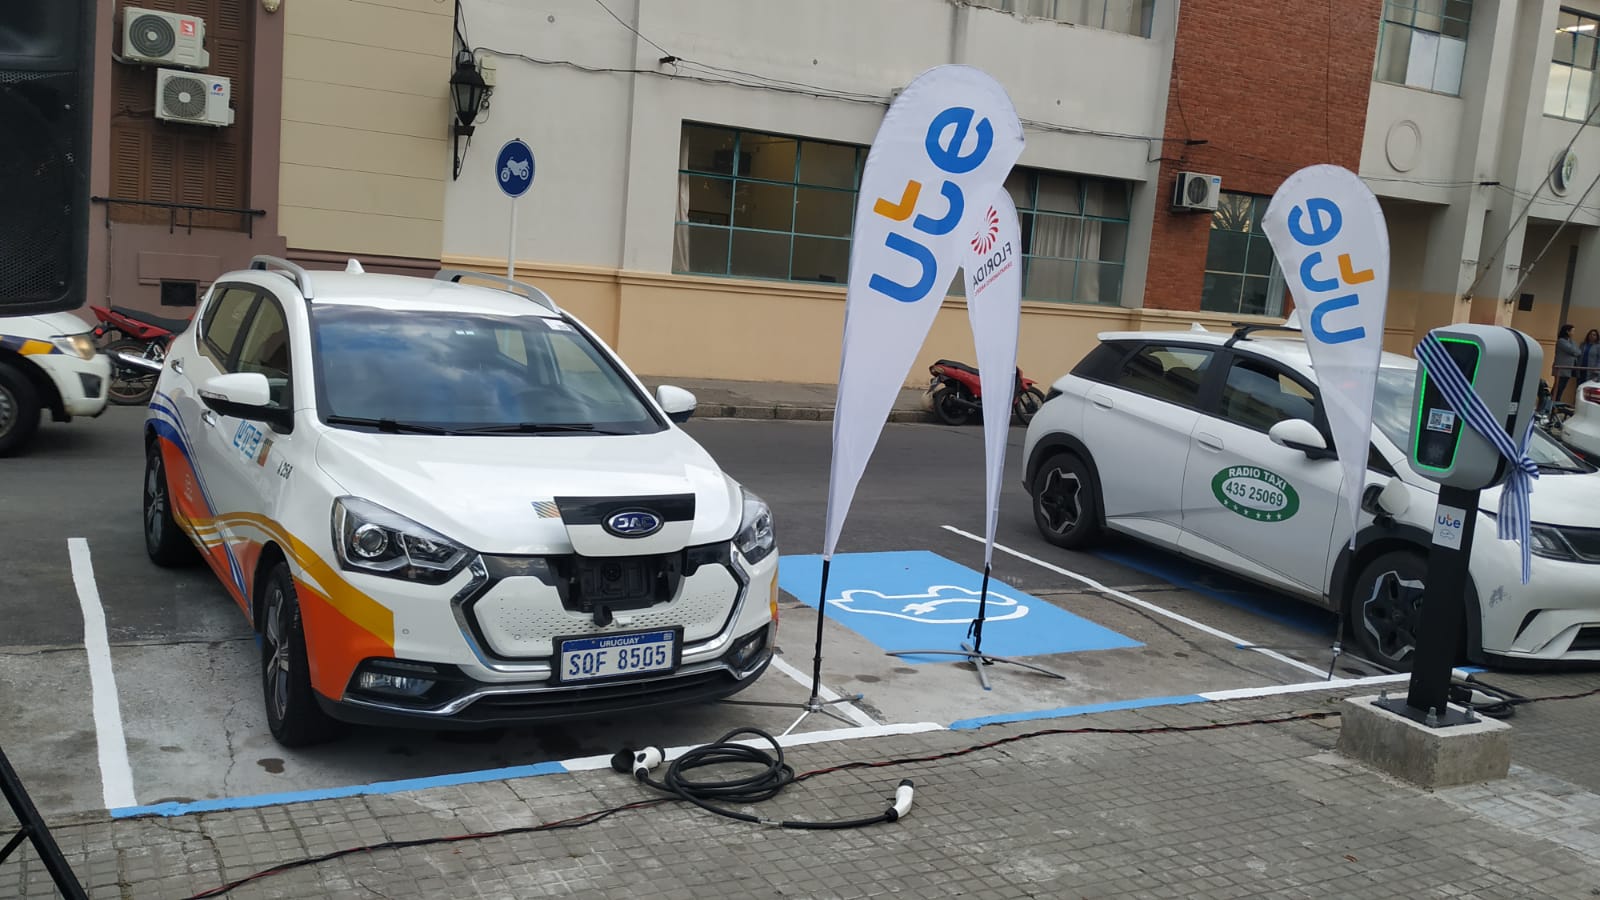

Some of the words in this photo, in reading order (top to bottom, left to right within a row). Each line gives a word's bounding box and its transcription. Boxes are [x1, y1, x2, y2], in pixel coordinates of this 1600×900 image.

[869, 107, 993, 302] ute
[1229, 467, 1260, 478] RADIO
[1263, 471, 1287, 490] TAXI
[1226, 481, 1246, 496] 435
[1249, 486, 1283, 507] 25069
[1438, 513, 1461, 528] ute
[599, 637, 640, 648] URUGUAY
[617, 645, 666, 670] 8505
